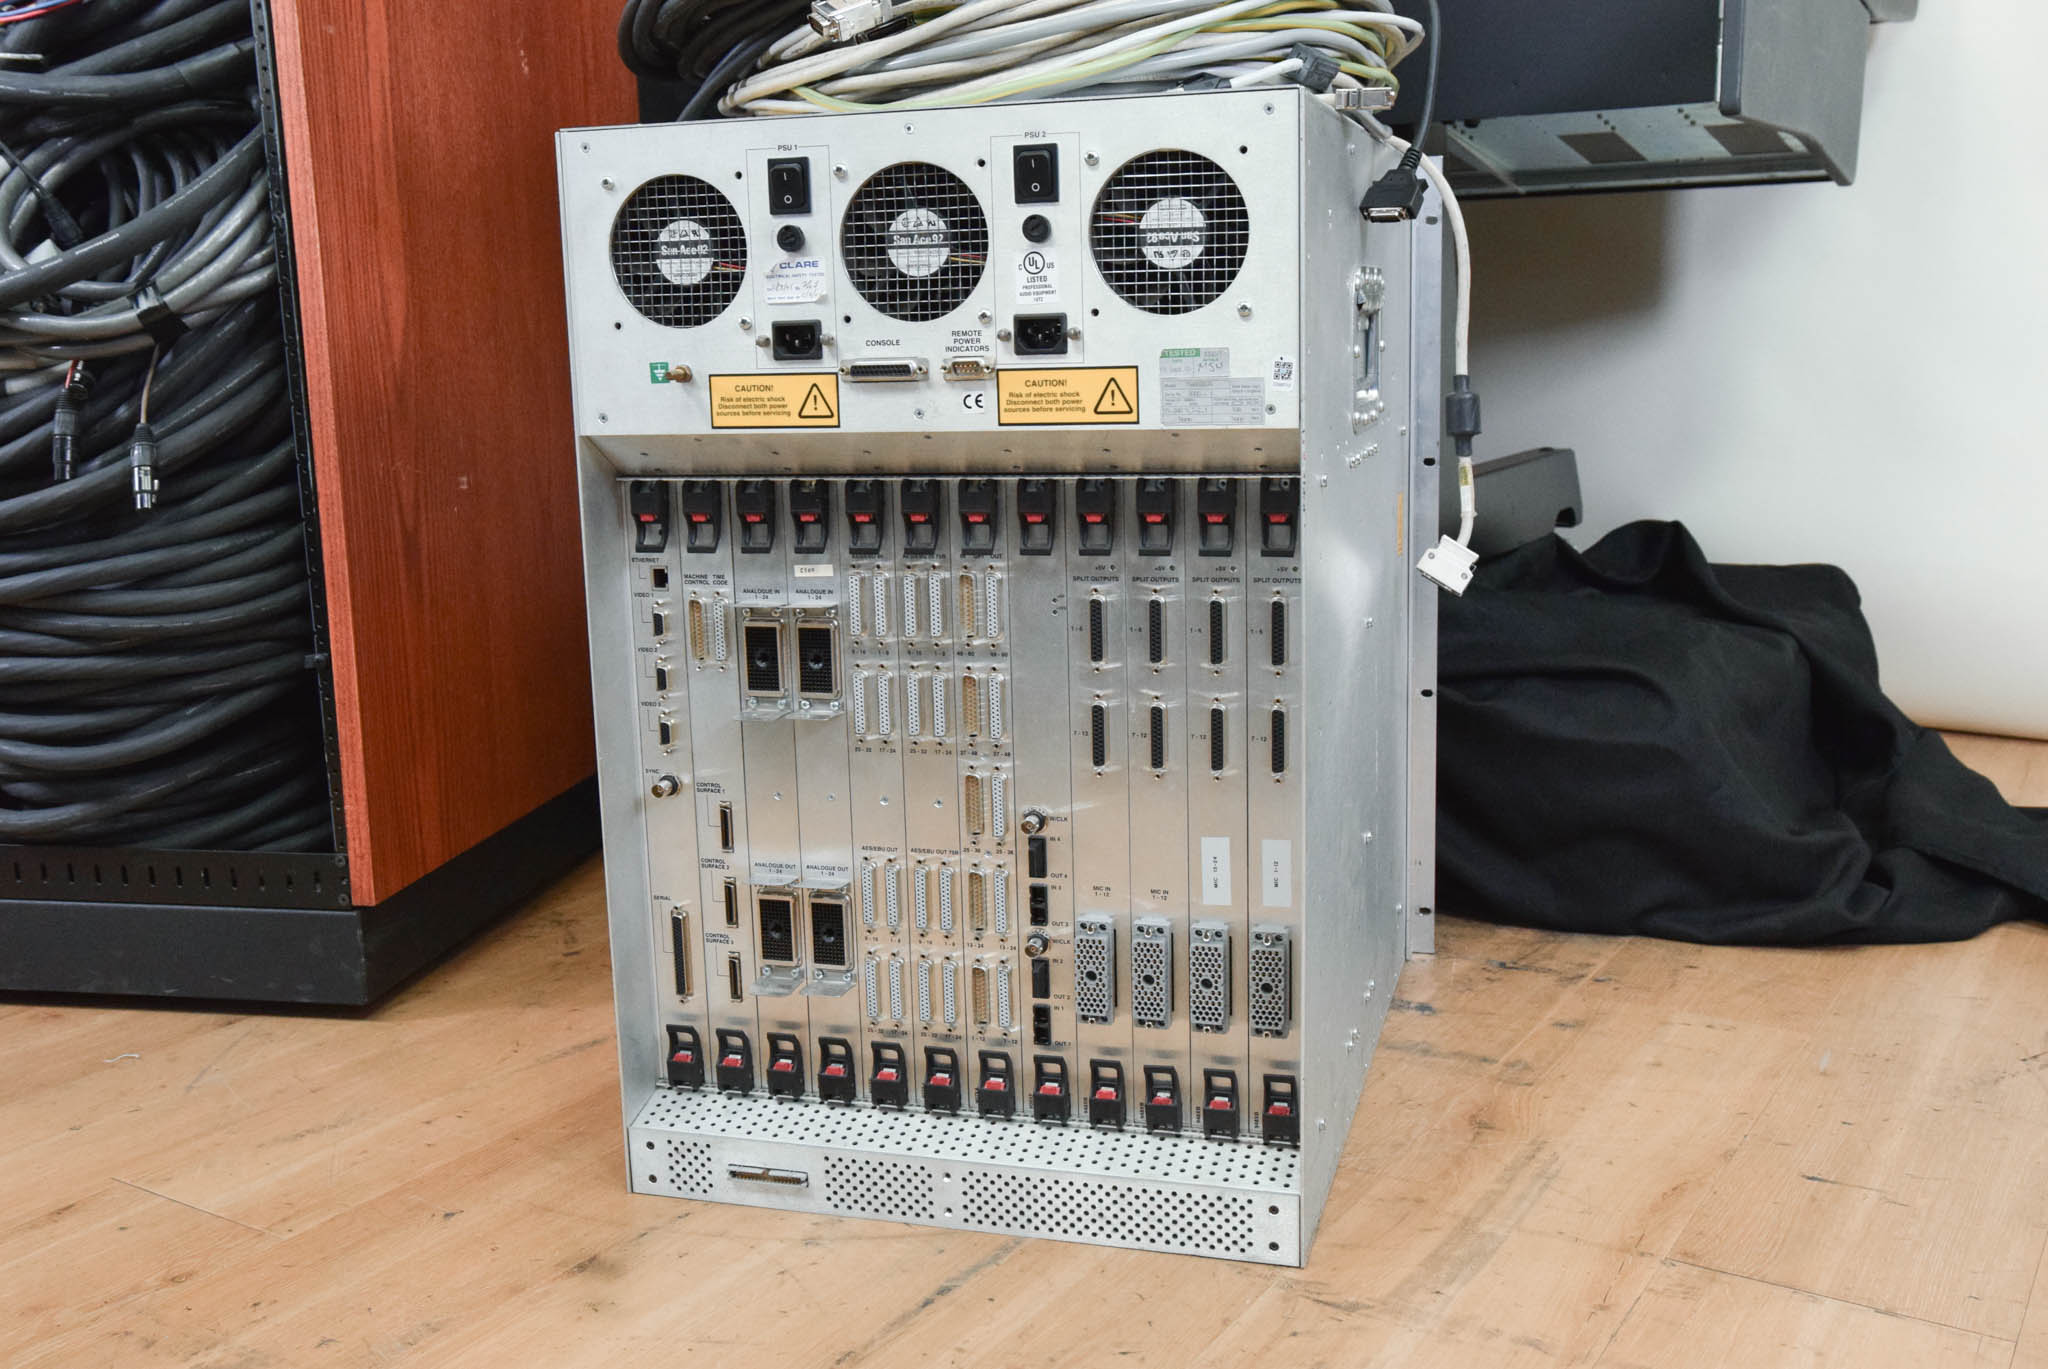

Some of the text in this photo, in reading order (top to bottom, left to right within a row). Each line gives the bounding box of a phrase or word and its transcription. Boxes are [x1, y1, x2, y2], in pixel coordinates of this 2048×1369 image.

[1024, 131, 1040, 139] PSU
[777, 144, 793, 152] PSU
[779, 260, 820, 270] CLARE
[1026, 276, 1048, 284] LISTED
[865, 339, 901, 347] CONSOLE
[734, 384, 774, 392] CAUTION!
[1025, 380, 1068, 388] CAUTION!
[962, 393, 984, 409] CE
